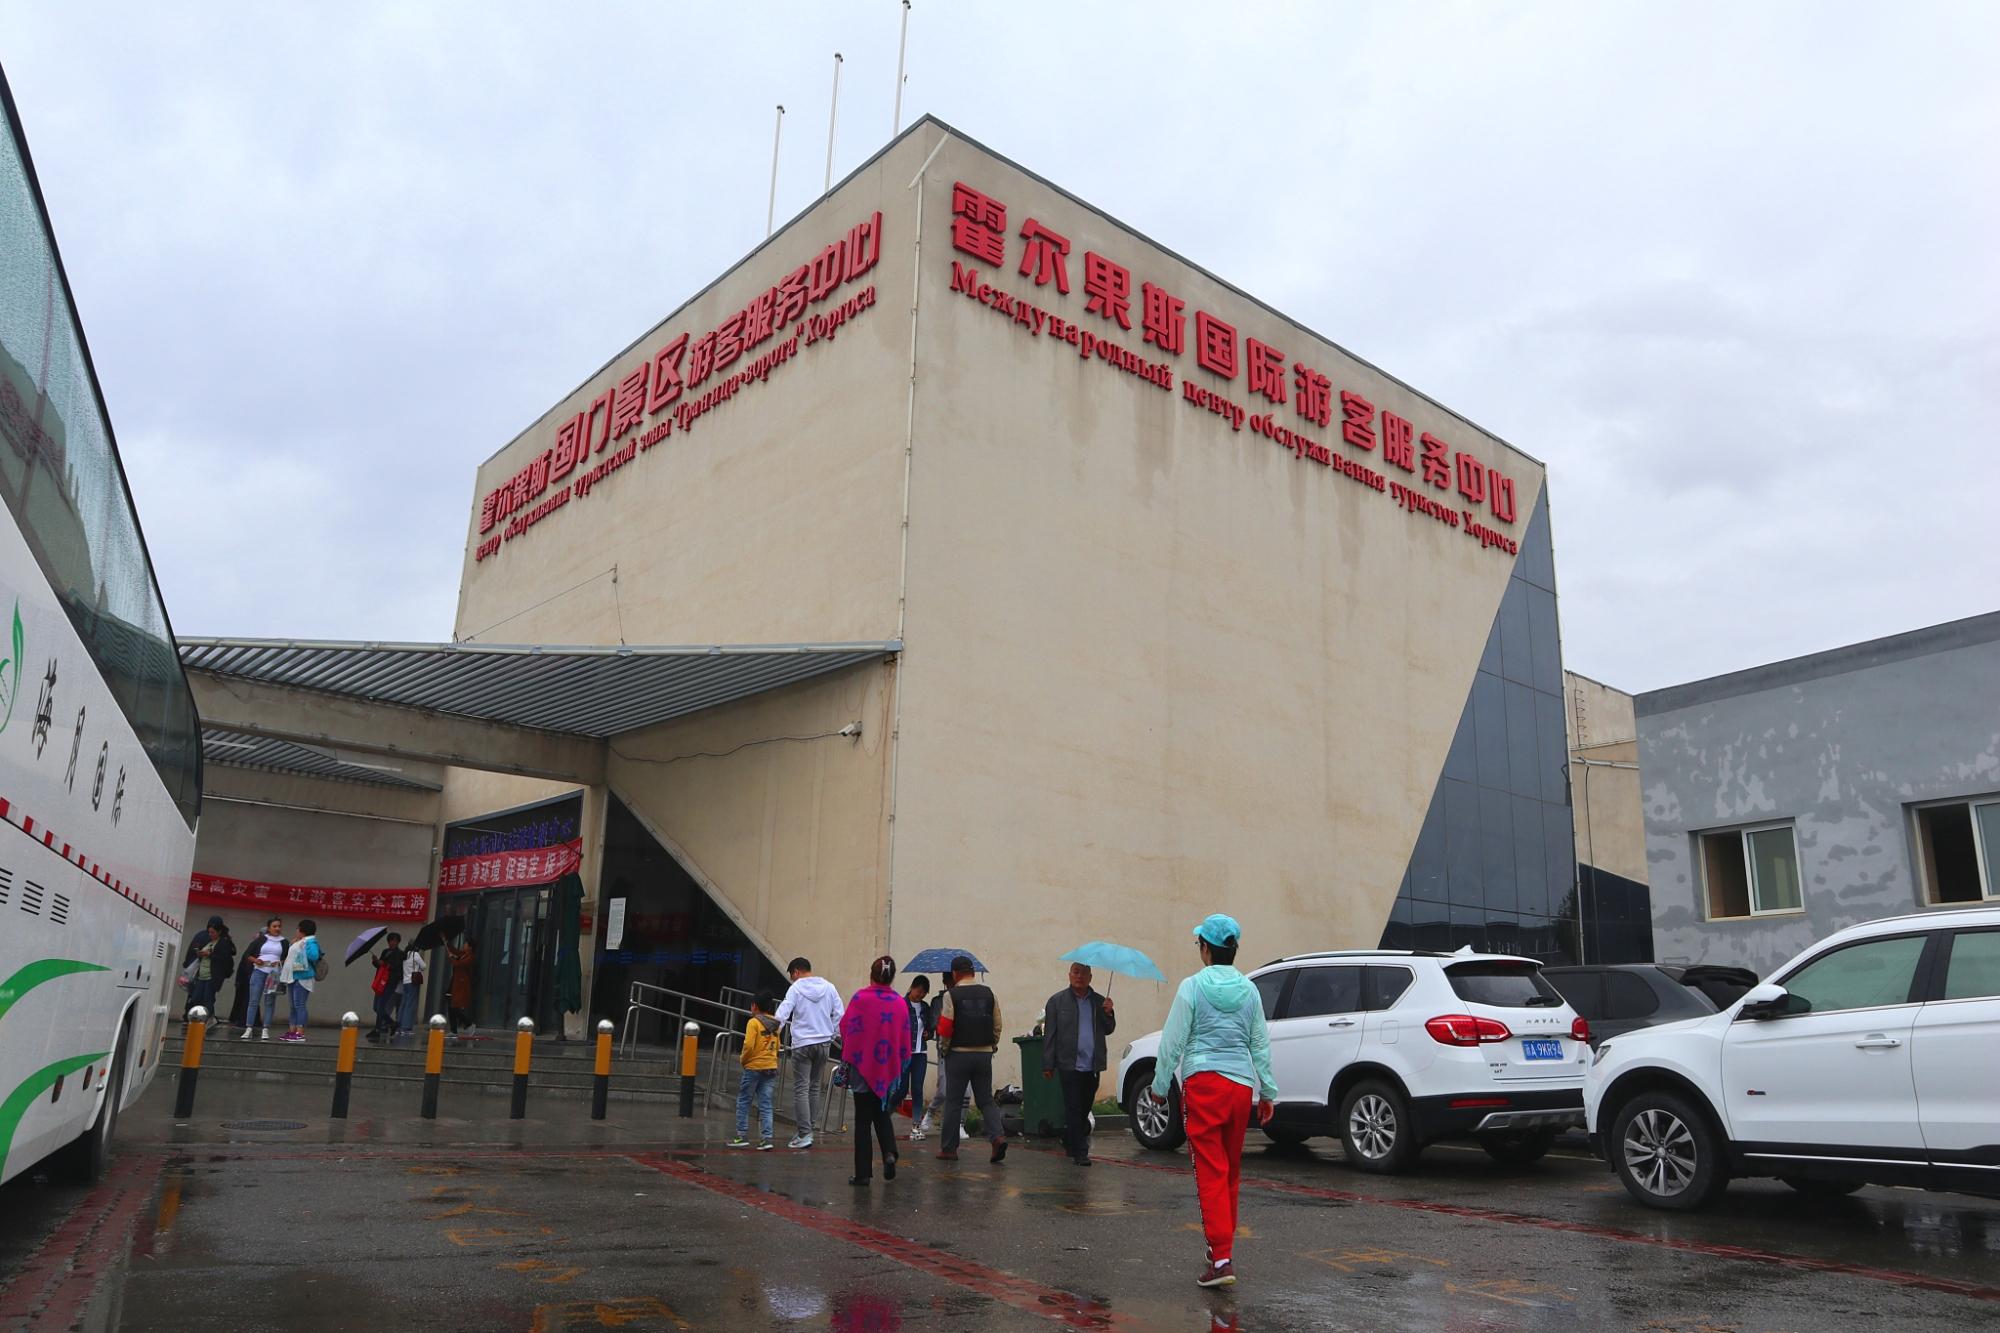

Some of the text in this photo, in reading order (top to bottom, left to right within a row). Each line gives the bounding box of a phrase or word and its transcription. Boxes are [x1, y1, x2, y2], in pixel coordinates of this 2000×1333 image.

[950, 260, 1173, 392] Международный
[1182, 380, 1246, 432] центр
[1389, 481, 1459, 528] туристов
[951, 181, 1517, 525] 霍尔果斯国际游客服务中心
